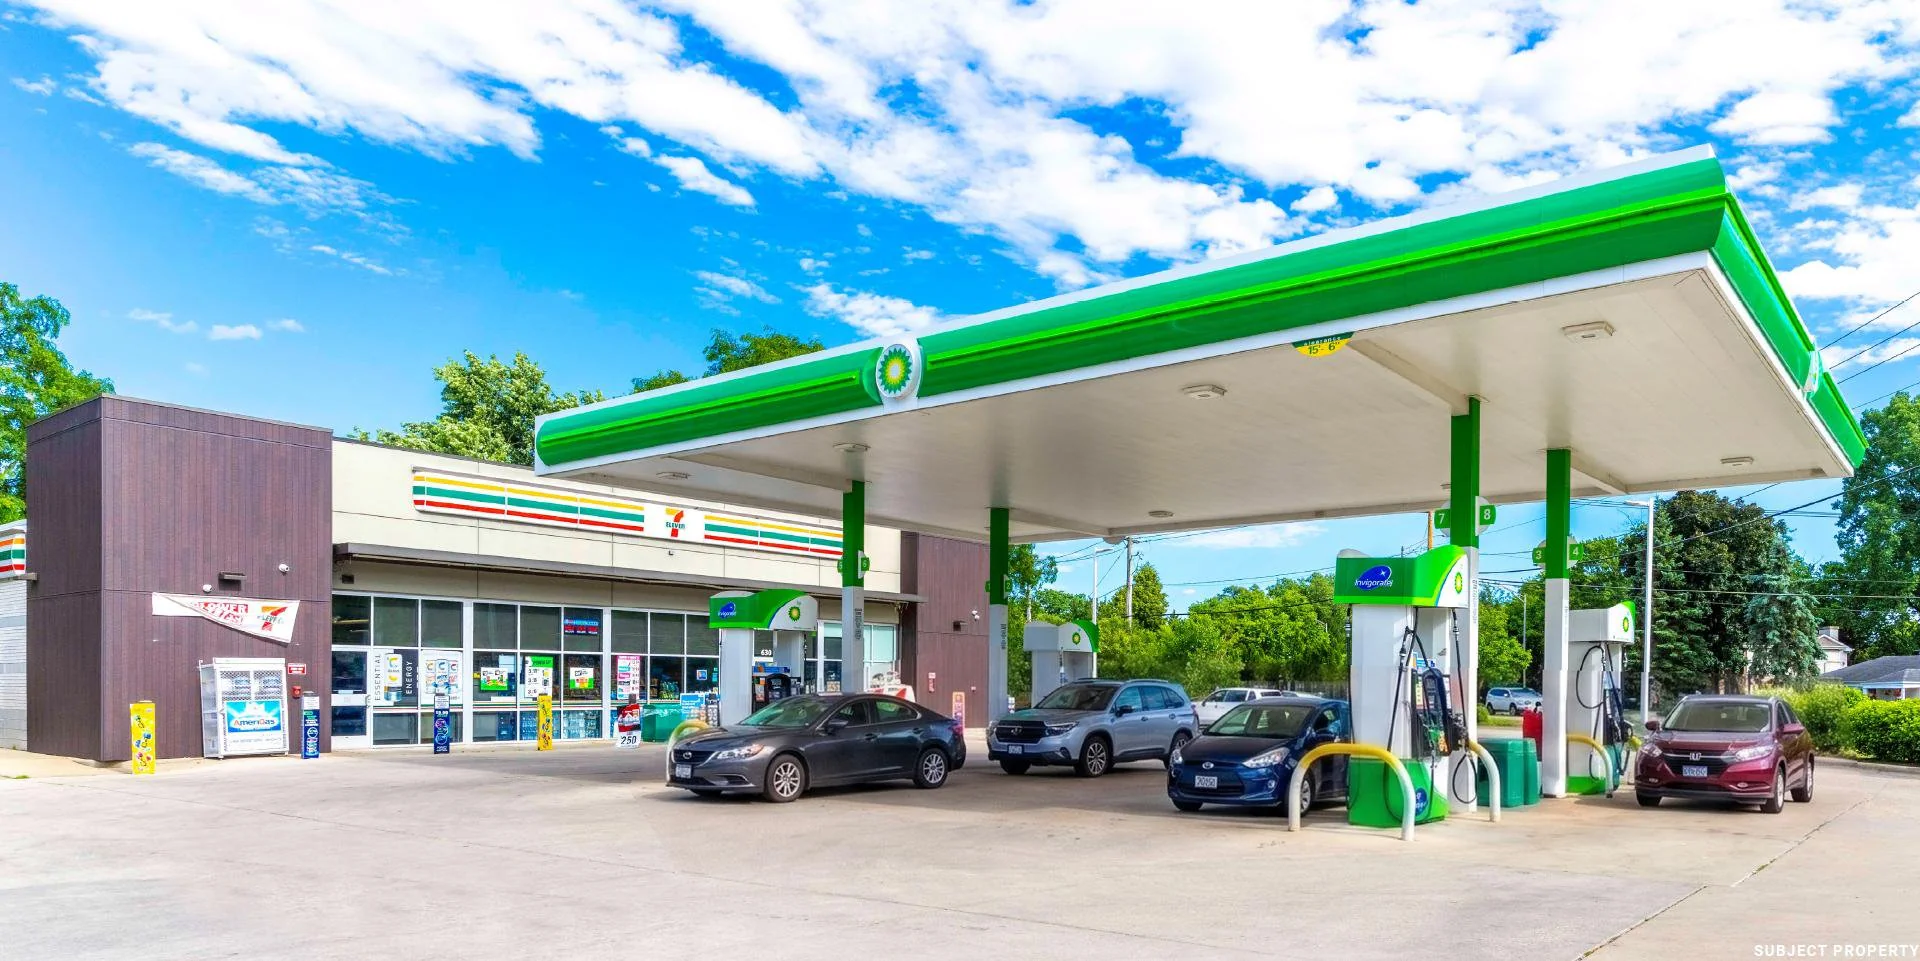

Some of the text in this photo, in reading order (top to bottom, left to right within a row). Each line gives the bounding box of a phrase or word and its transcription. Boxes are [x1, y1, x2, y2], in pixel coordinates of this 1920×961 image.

[1438, 513, 1445, 525] 7
[1483, 508, 1491, 520] 8
[1535, 550, 1542, 560] 3
[1572, 547, 1579, 556] 4
[862, 559, 868, 568] 6
[405, 660, 413, 695] ENERGY
[233, 718, 276, 727] AmeriGas
[620, 735, 637, 745] 250
